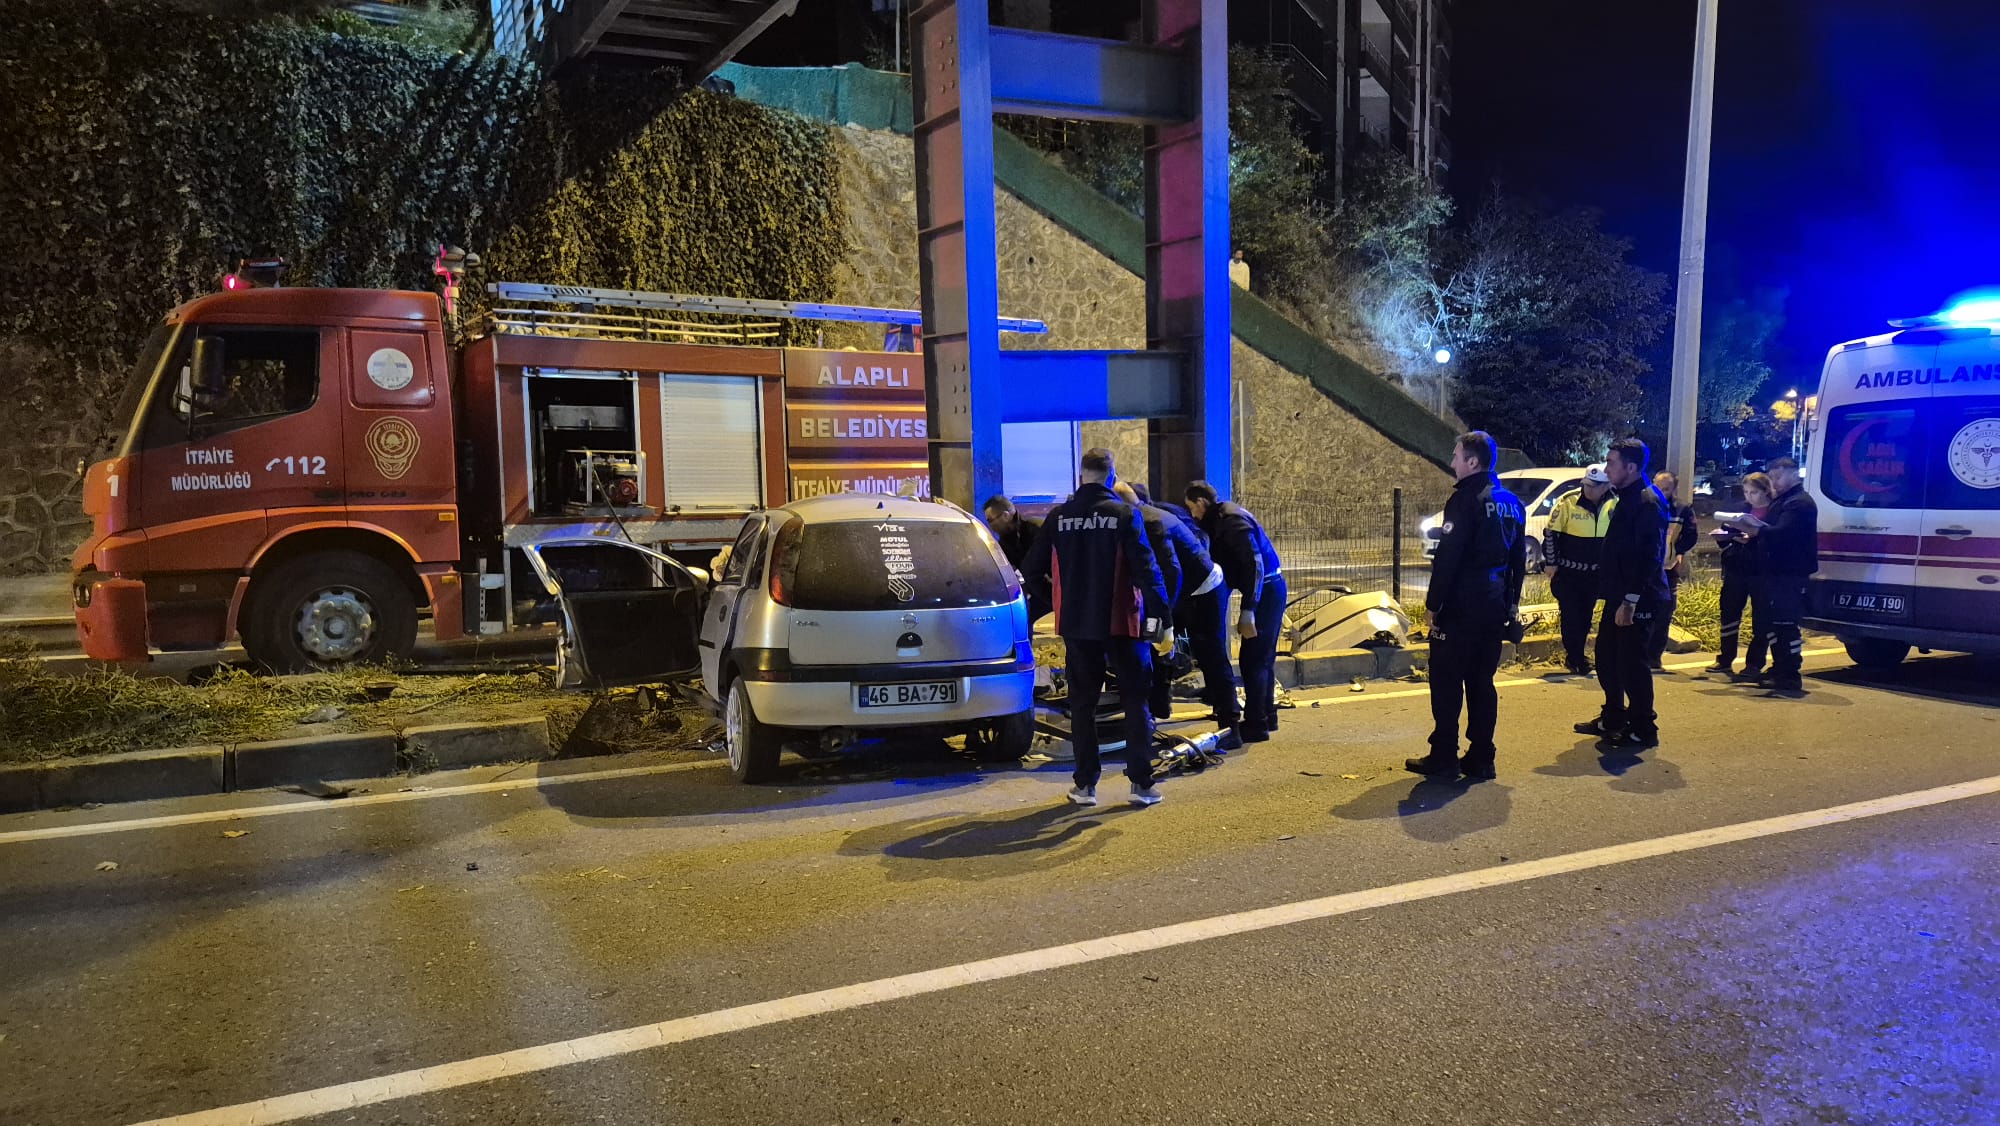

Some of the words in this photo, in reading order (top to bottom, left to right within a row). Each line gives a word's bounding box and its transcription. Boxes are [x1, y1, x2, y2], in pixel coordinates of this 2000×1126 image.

[817, 366, 909, 387] ALAPLI
[800, 414, 928, 438] BELEDİYES
[185, 447, 234, 465] İTFAİYE
[284, 456, 326, 475] 112
[106, 474, 119, 497] 1
[171, 471, 251, 491] MÜDÜRLÜĞÜ
[1058, 511, 1118, 532] İTFAİYE
[1839, 594, 1851, 606] 67
[1856, 595, 1876, 608] ADZ
[1882, 597, 1901, 610] 190
[869, 687, 888, 703] 46
[898, 685, 921, 703] BA
[929, 684, 955, 701] 791
